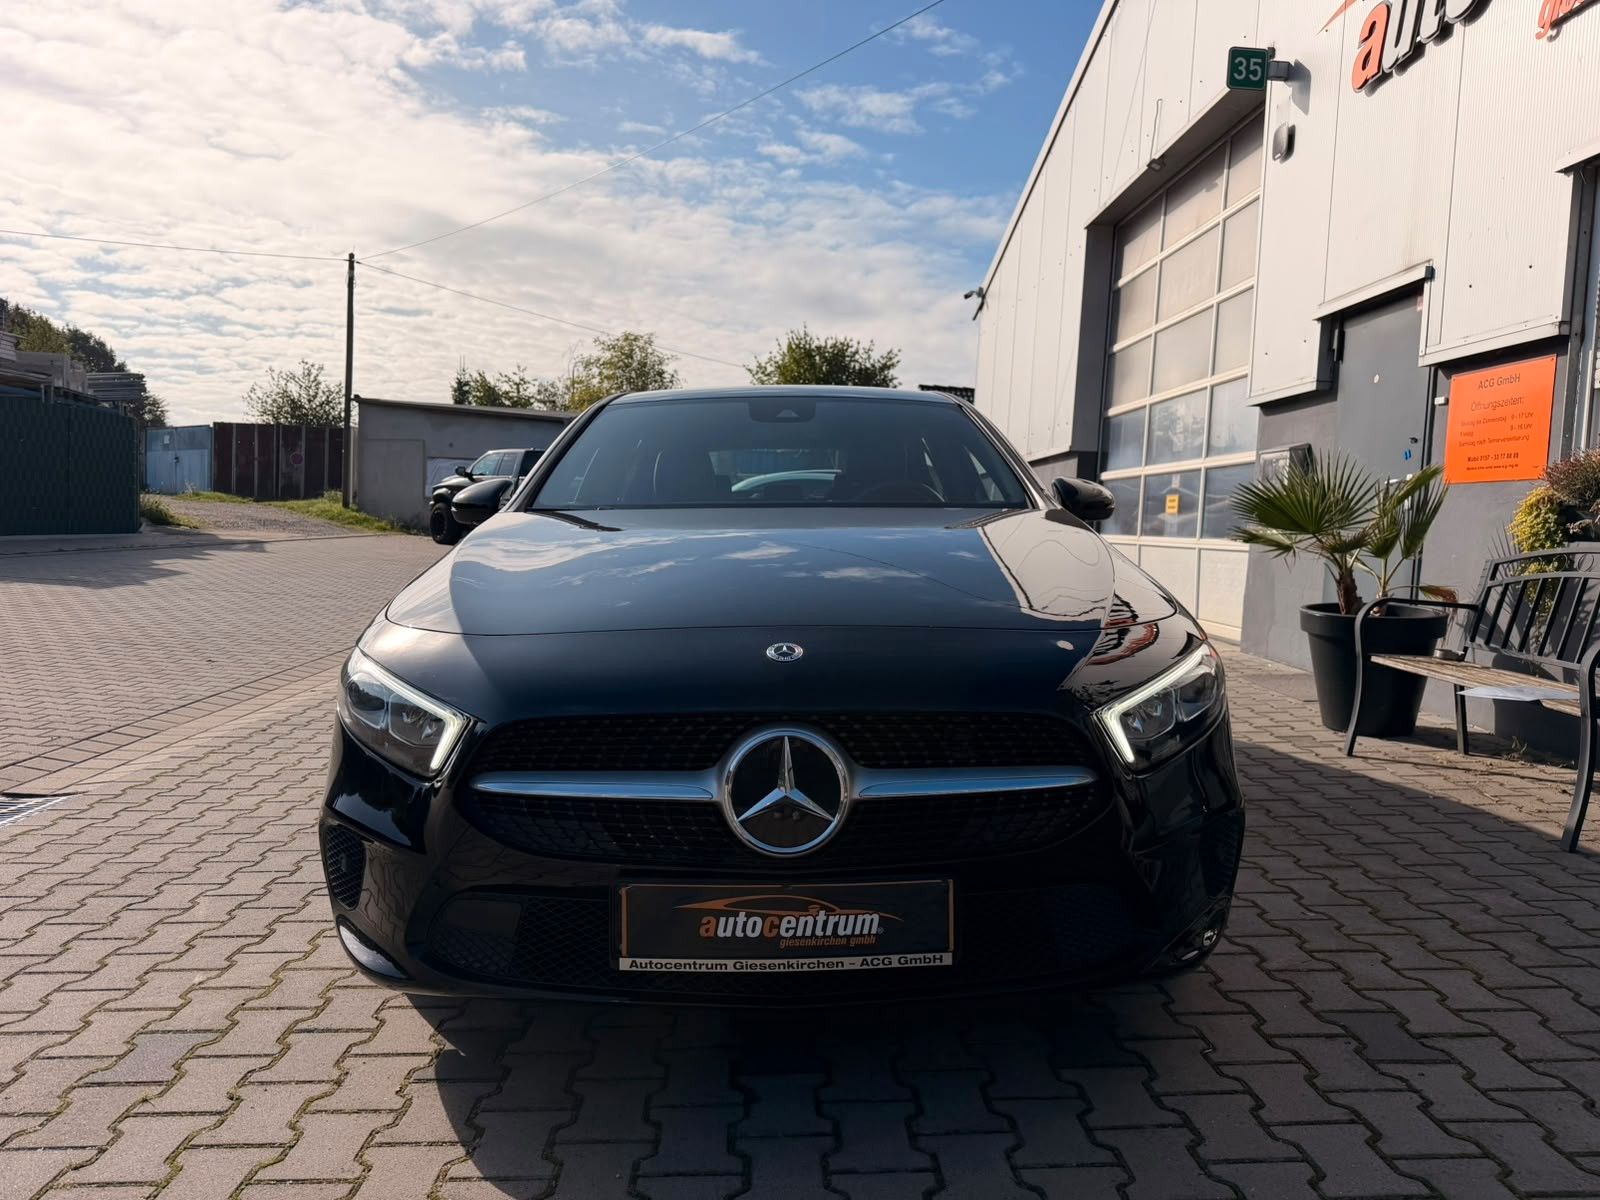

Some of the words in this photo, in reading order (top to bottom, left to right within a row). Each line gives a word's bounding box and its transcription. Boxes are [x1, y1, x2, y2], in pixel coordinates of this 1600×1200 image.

[1232, 56, 1263, 81] 35
[1478, 378, 1495, 390] ACG
[1496, 373, 1521, 386] GmbH
[699, 910, 881, 939] autocentrum
[779, 936, 847, 949] giesenkirchen
[849, 934, 877, 947] gmbh
[628, 959, 729, 971] Autocentrum
[732, 957, 847, 971] Giesenkirchen
[859, 956, 893, 967] ACG
[897, 954, 944, 966] GmbH
